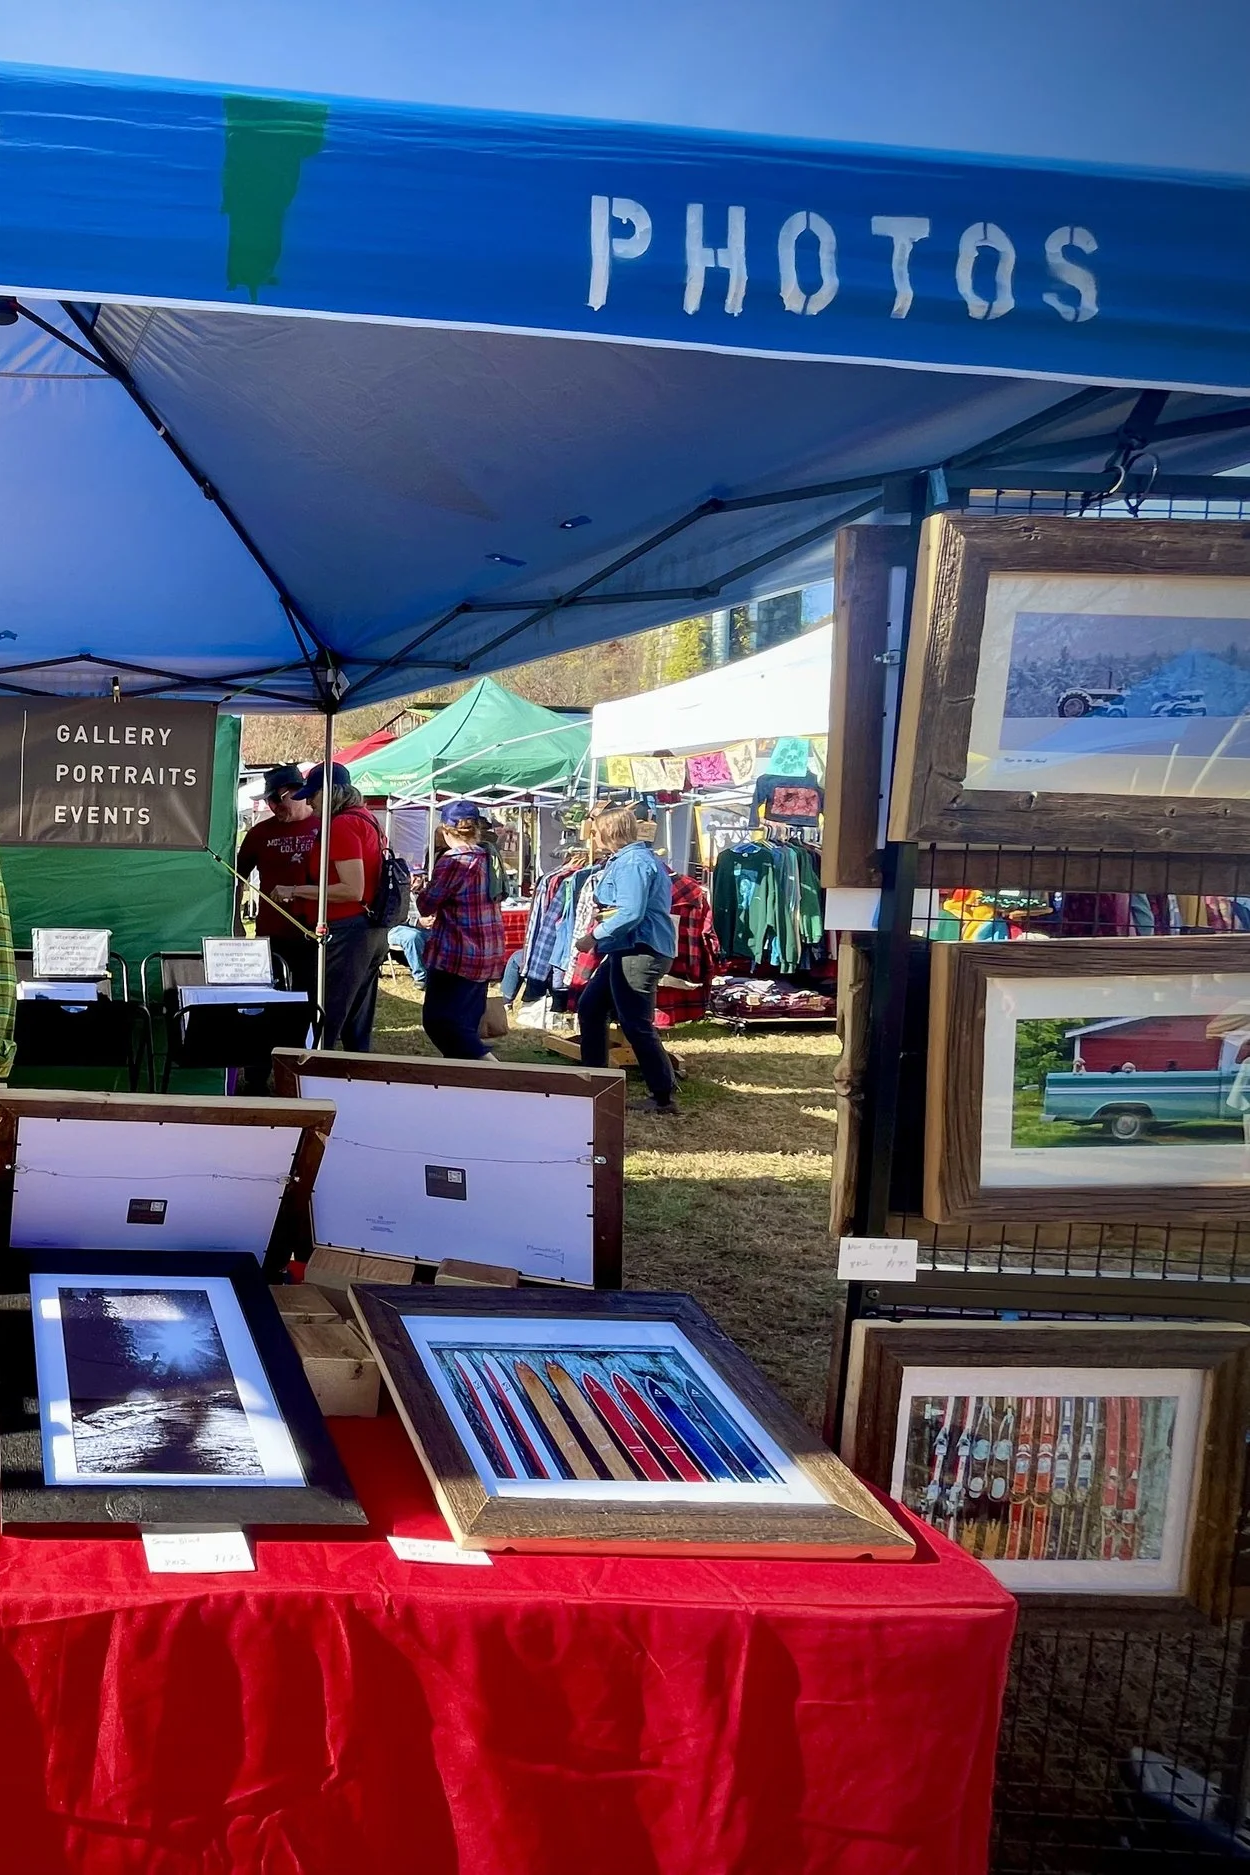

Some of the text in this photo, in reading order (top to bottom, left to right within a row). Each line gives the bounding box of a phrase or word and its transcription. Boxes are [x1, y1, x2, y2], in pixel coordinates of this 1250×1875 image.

[585, 194, 1101, 323] PHOTOS
[56, 724, 172, 746] GALLERY
[55, 764, 197, 786] PORTRAITS
[54, 805, 150, 825] EVENTS
